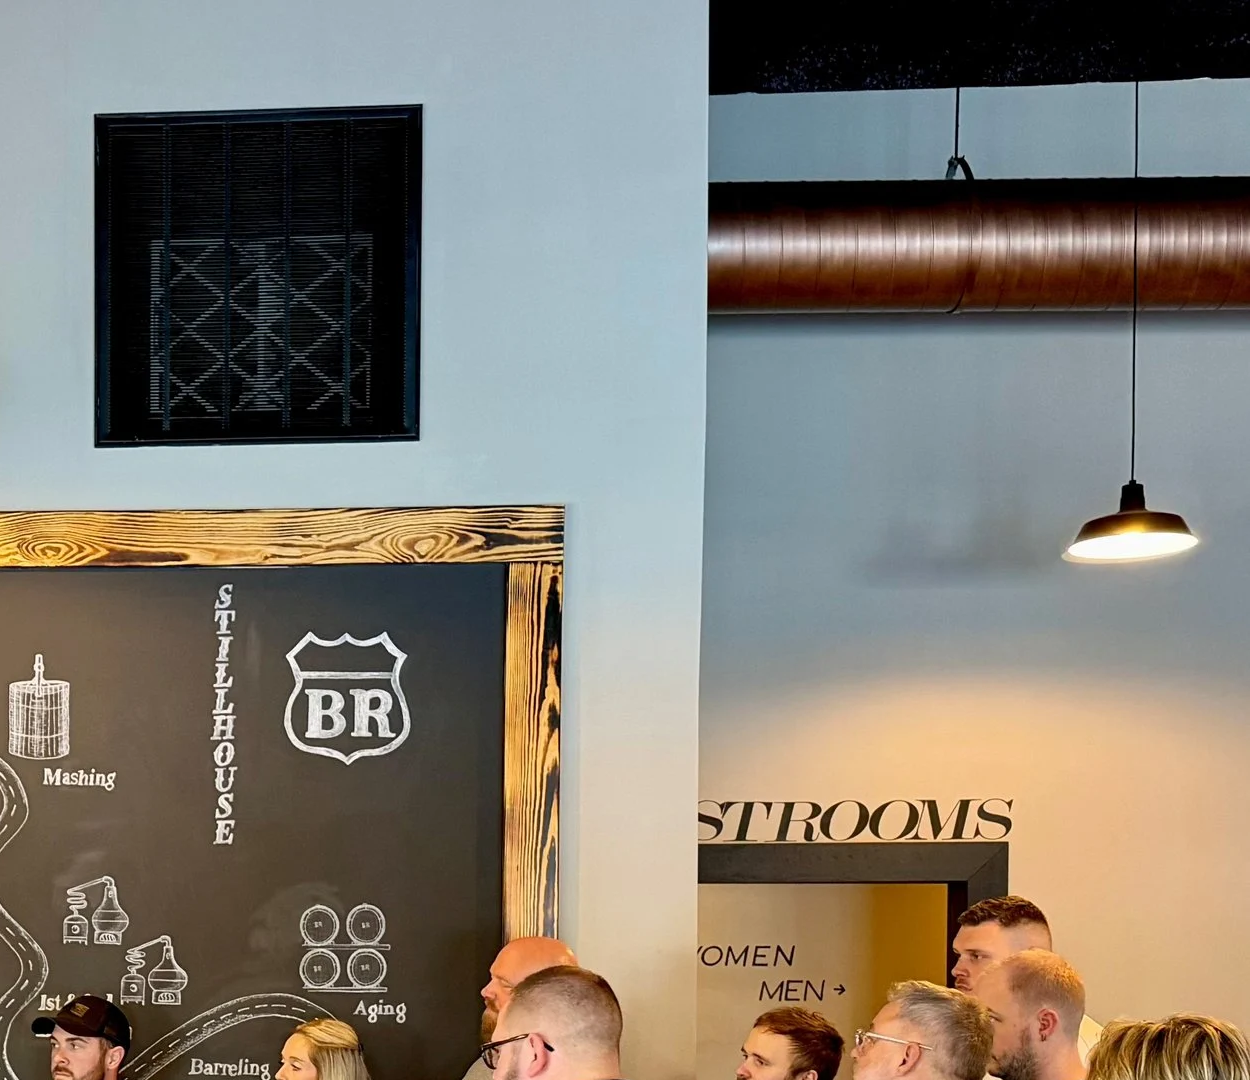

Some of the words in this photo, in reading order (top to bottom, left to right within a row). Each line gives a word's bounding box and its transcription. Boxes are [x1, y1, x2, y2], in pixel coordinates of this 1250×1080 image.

[210, 583, 238, 845] STILLHOUSE
[303, 687, 397, 740] BR
[42, 767, 117, 791] Mashing
[759, 979, 825, 1002] MEN
[353, 999, 407, 1024] Aging
[188, 1057, 271, 1080] Barreling
